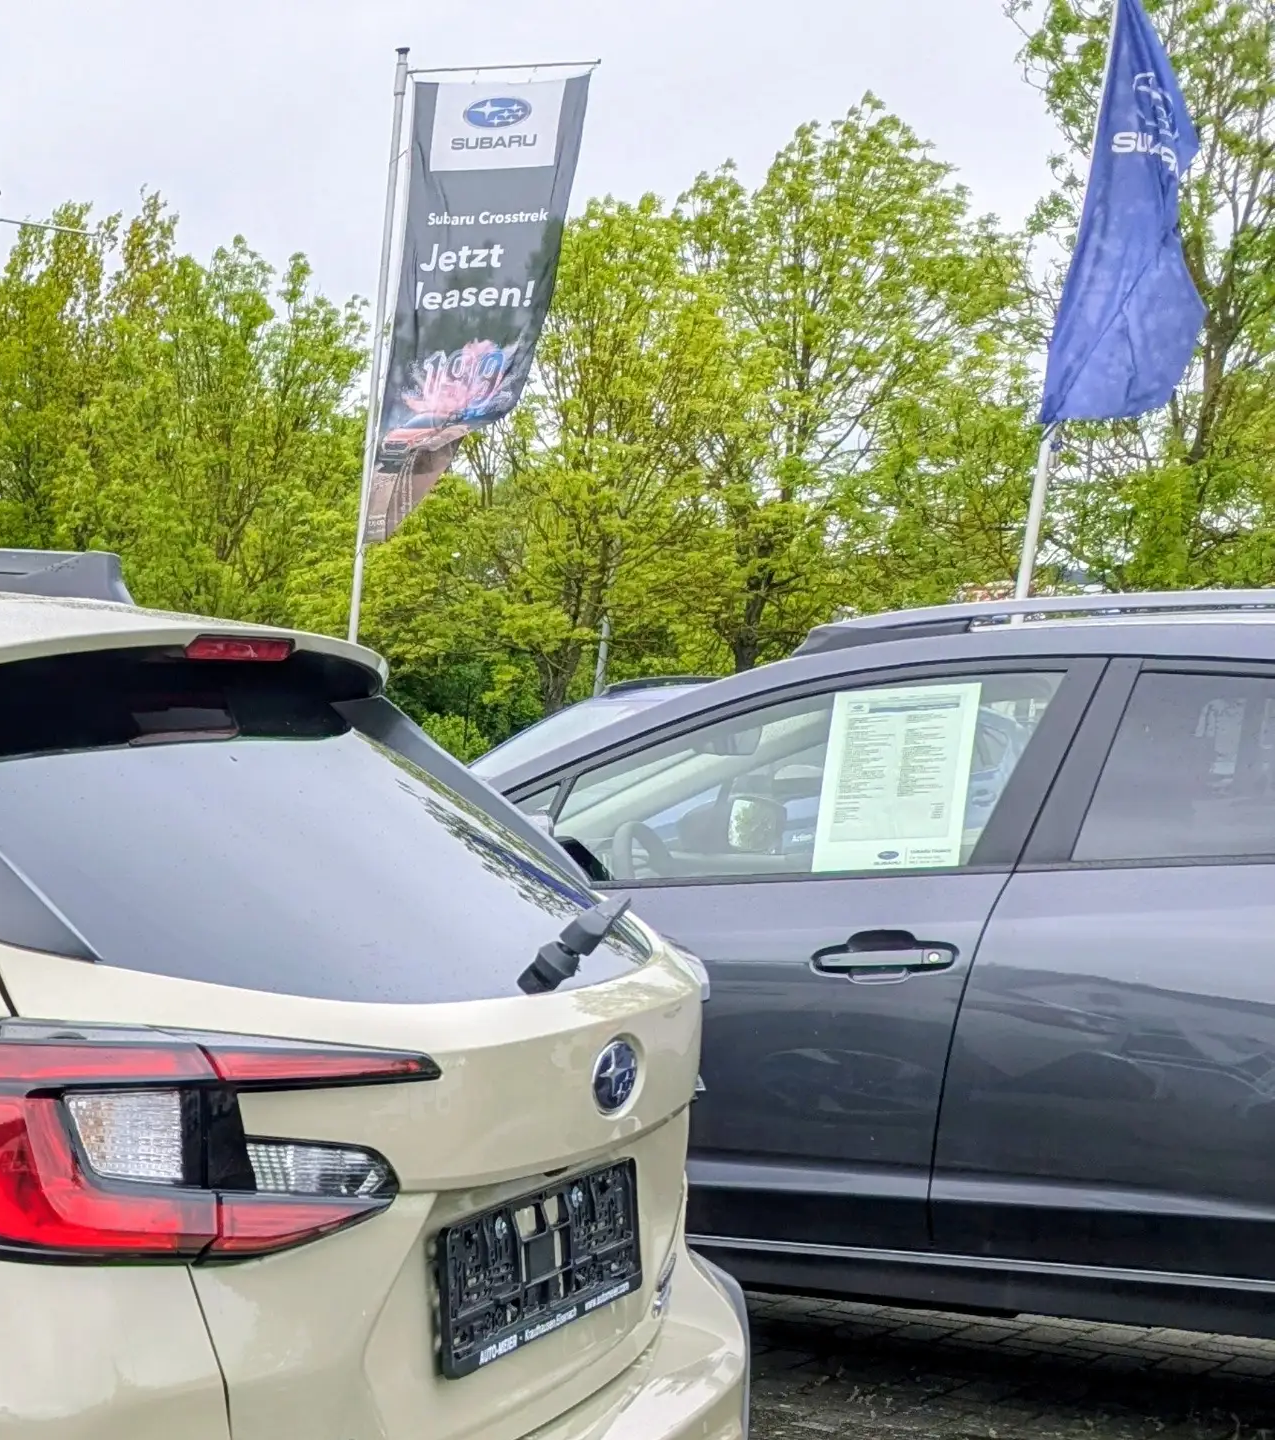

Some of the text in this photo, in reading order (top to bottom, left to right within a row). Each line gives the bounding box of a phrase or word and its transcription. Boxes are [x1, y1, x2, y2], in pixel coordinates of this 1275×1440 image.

[450, 133, 538, 151] SUBARU
[427, 207, 549, 227] Subaru Crosstrek
[419, 243, 505, 273] Jetzt
[414, 280, 536, 311] leasen!
